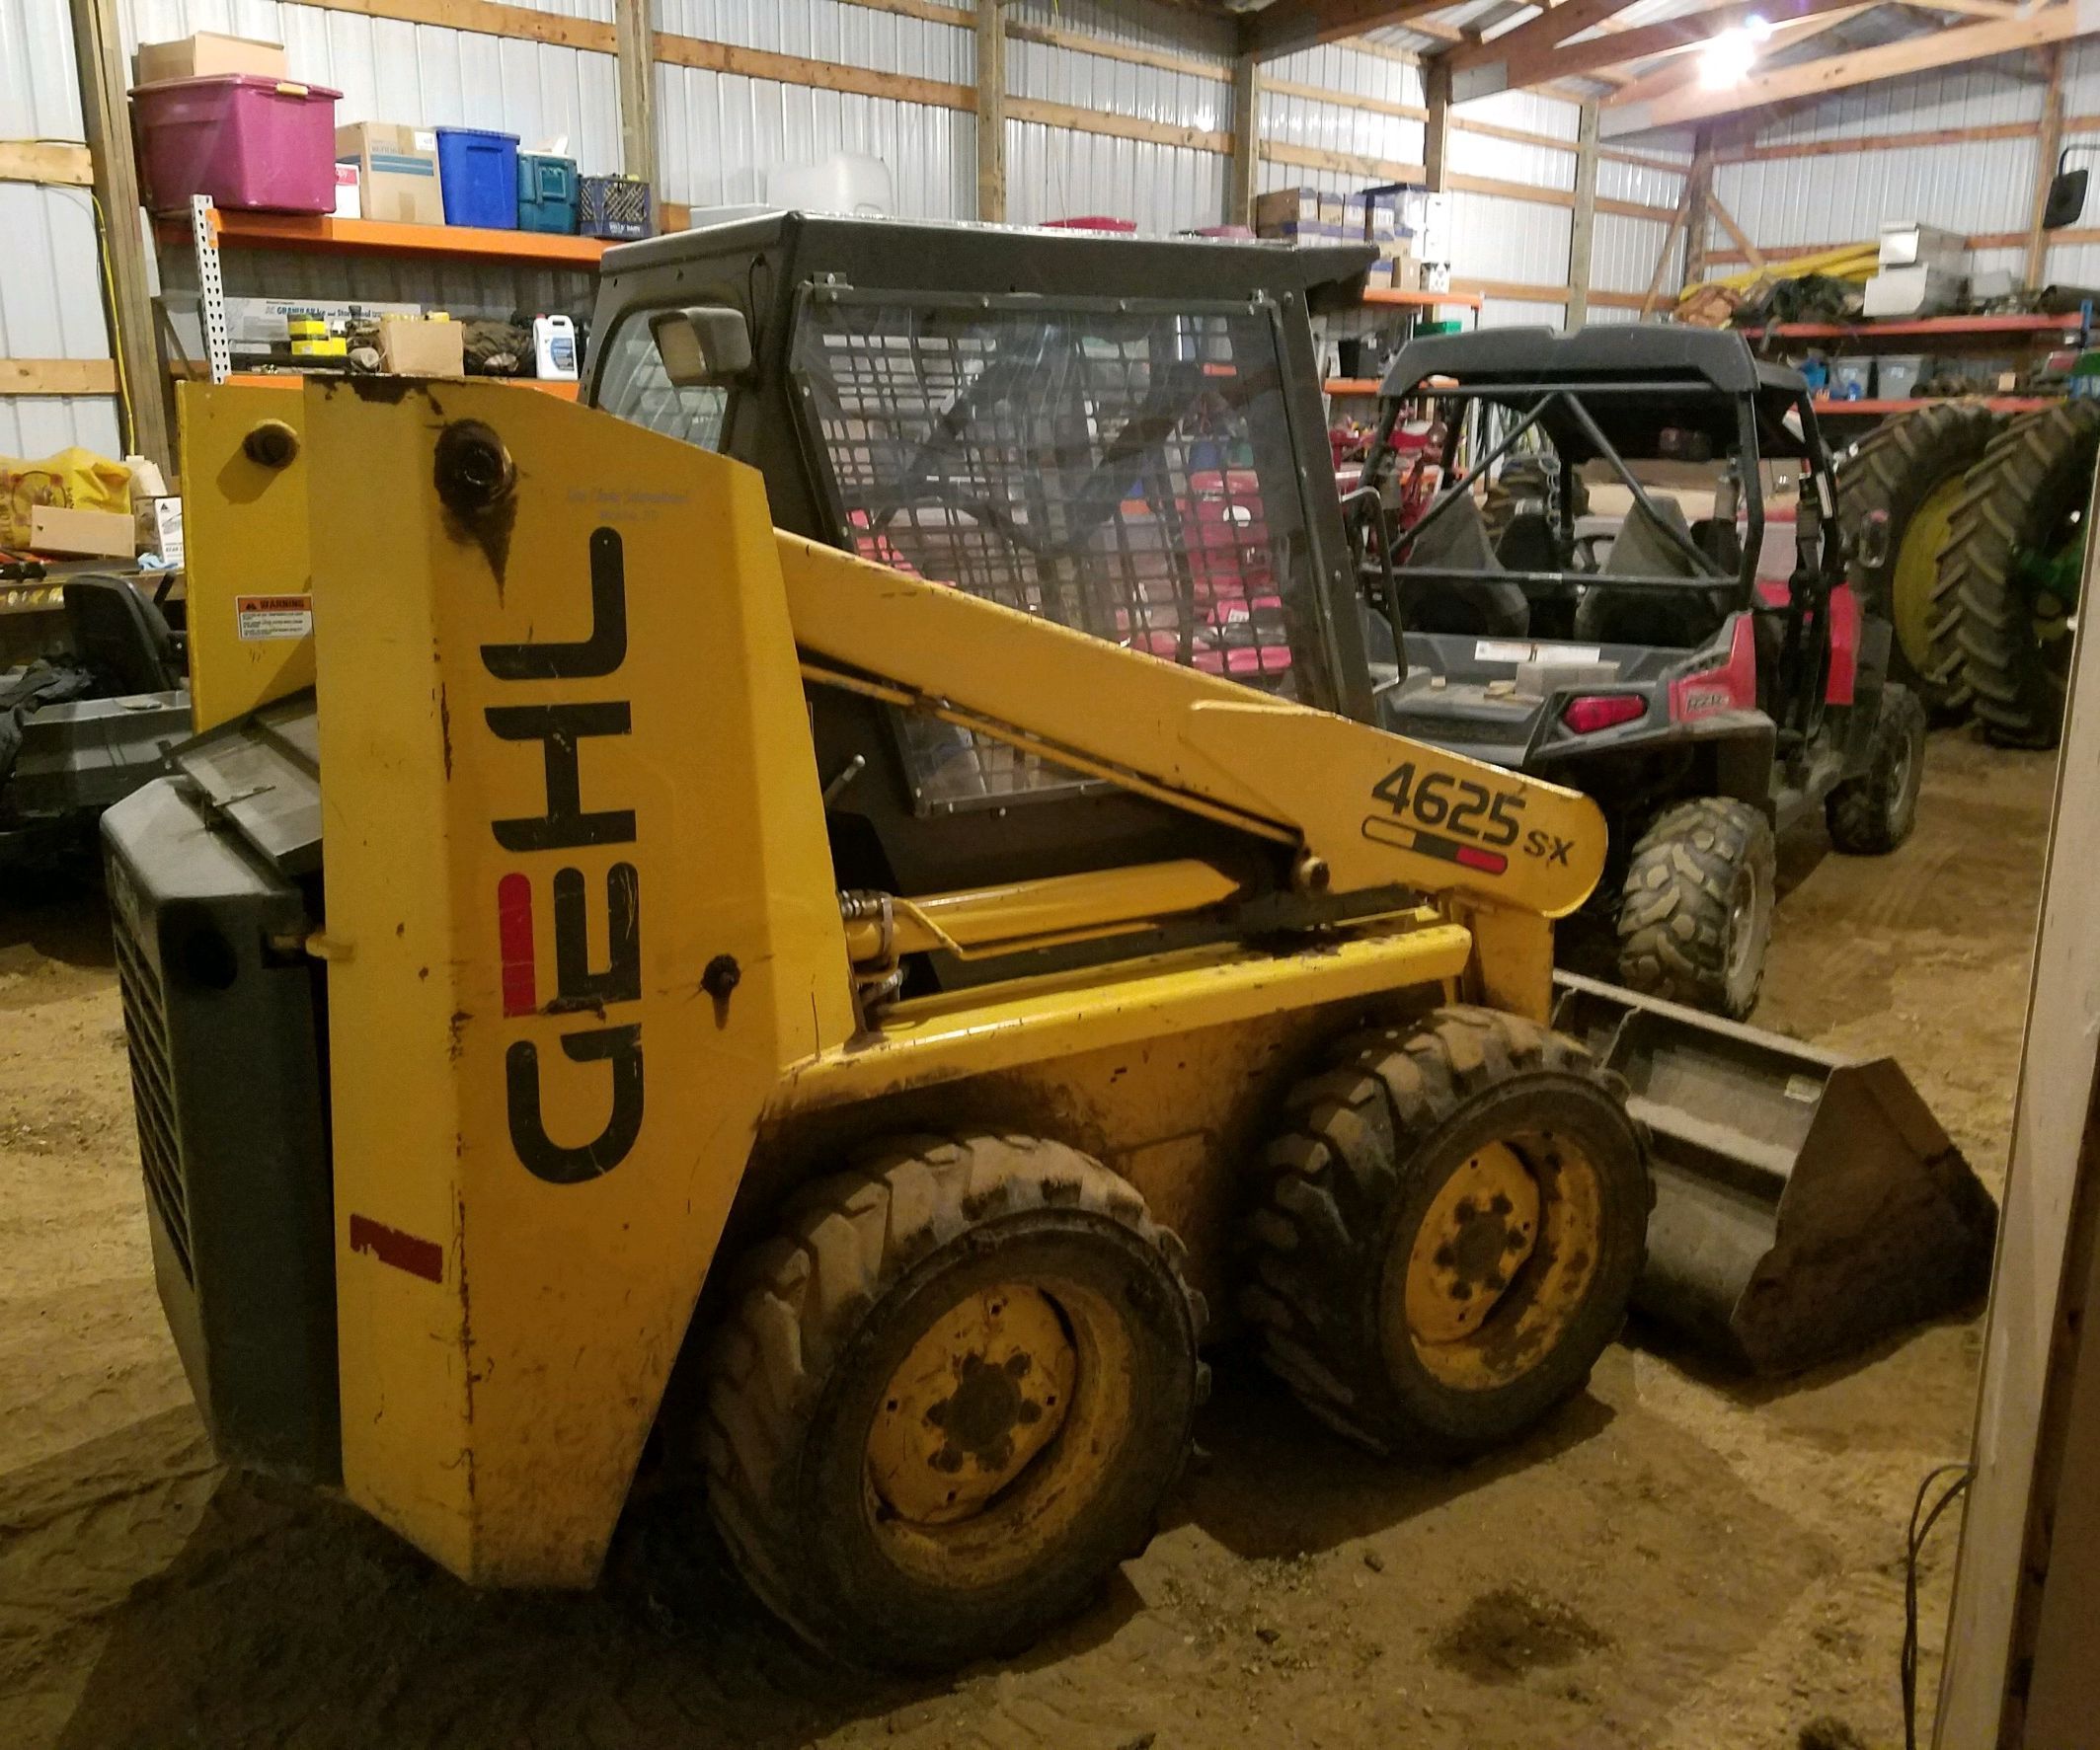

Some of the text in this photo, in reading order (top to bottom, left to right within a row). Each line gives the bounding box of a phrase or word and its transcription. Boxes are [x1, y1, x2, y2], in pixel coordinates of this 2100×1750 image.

[260, 599, 304, 609] WARNING
[480, 526, 645, 1184] GEHL
[1371, 761, 1575, 867] 4625 SX
